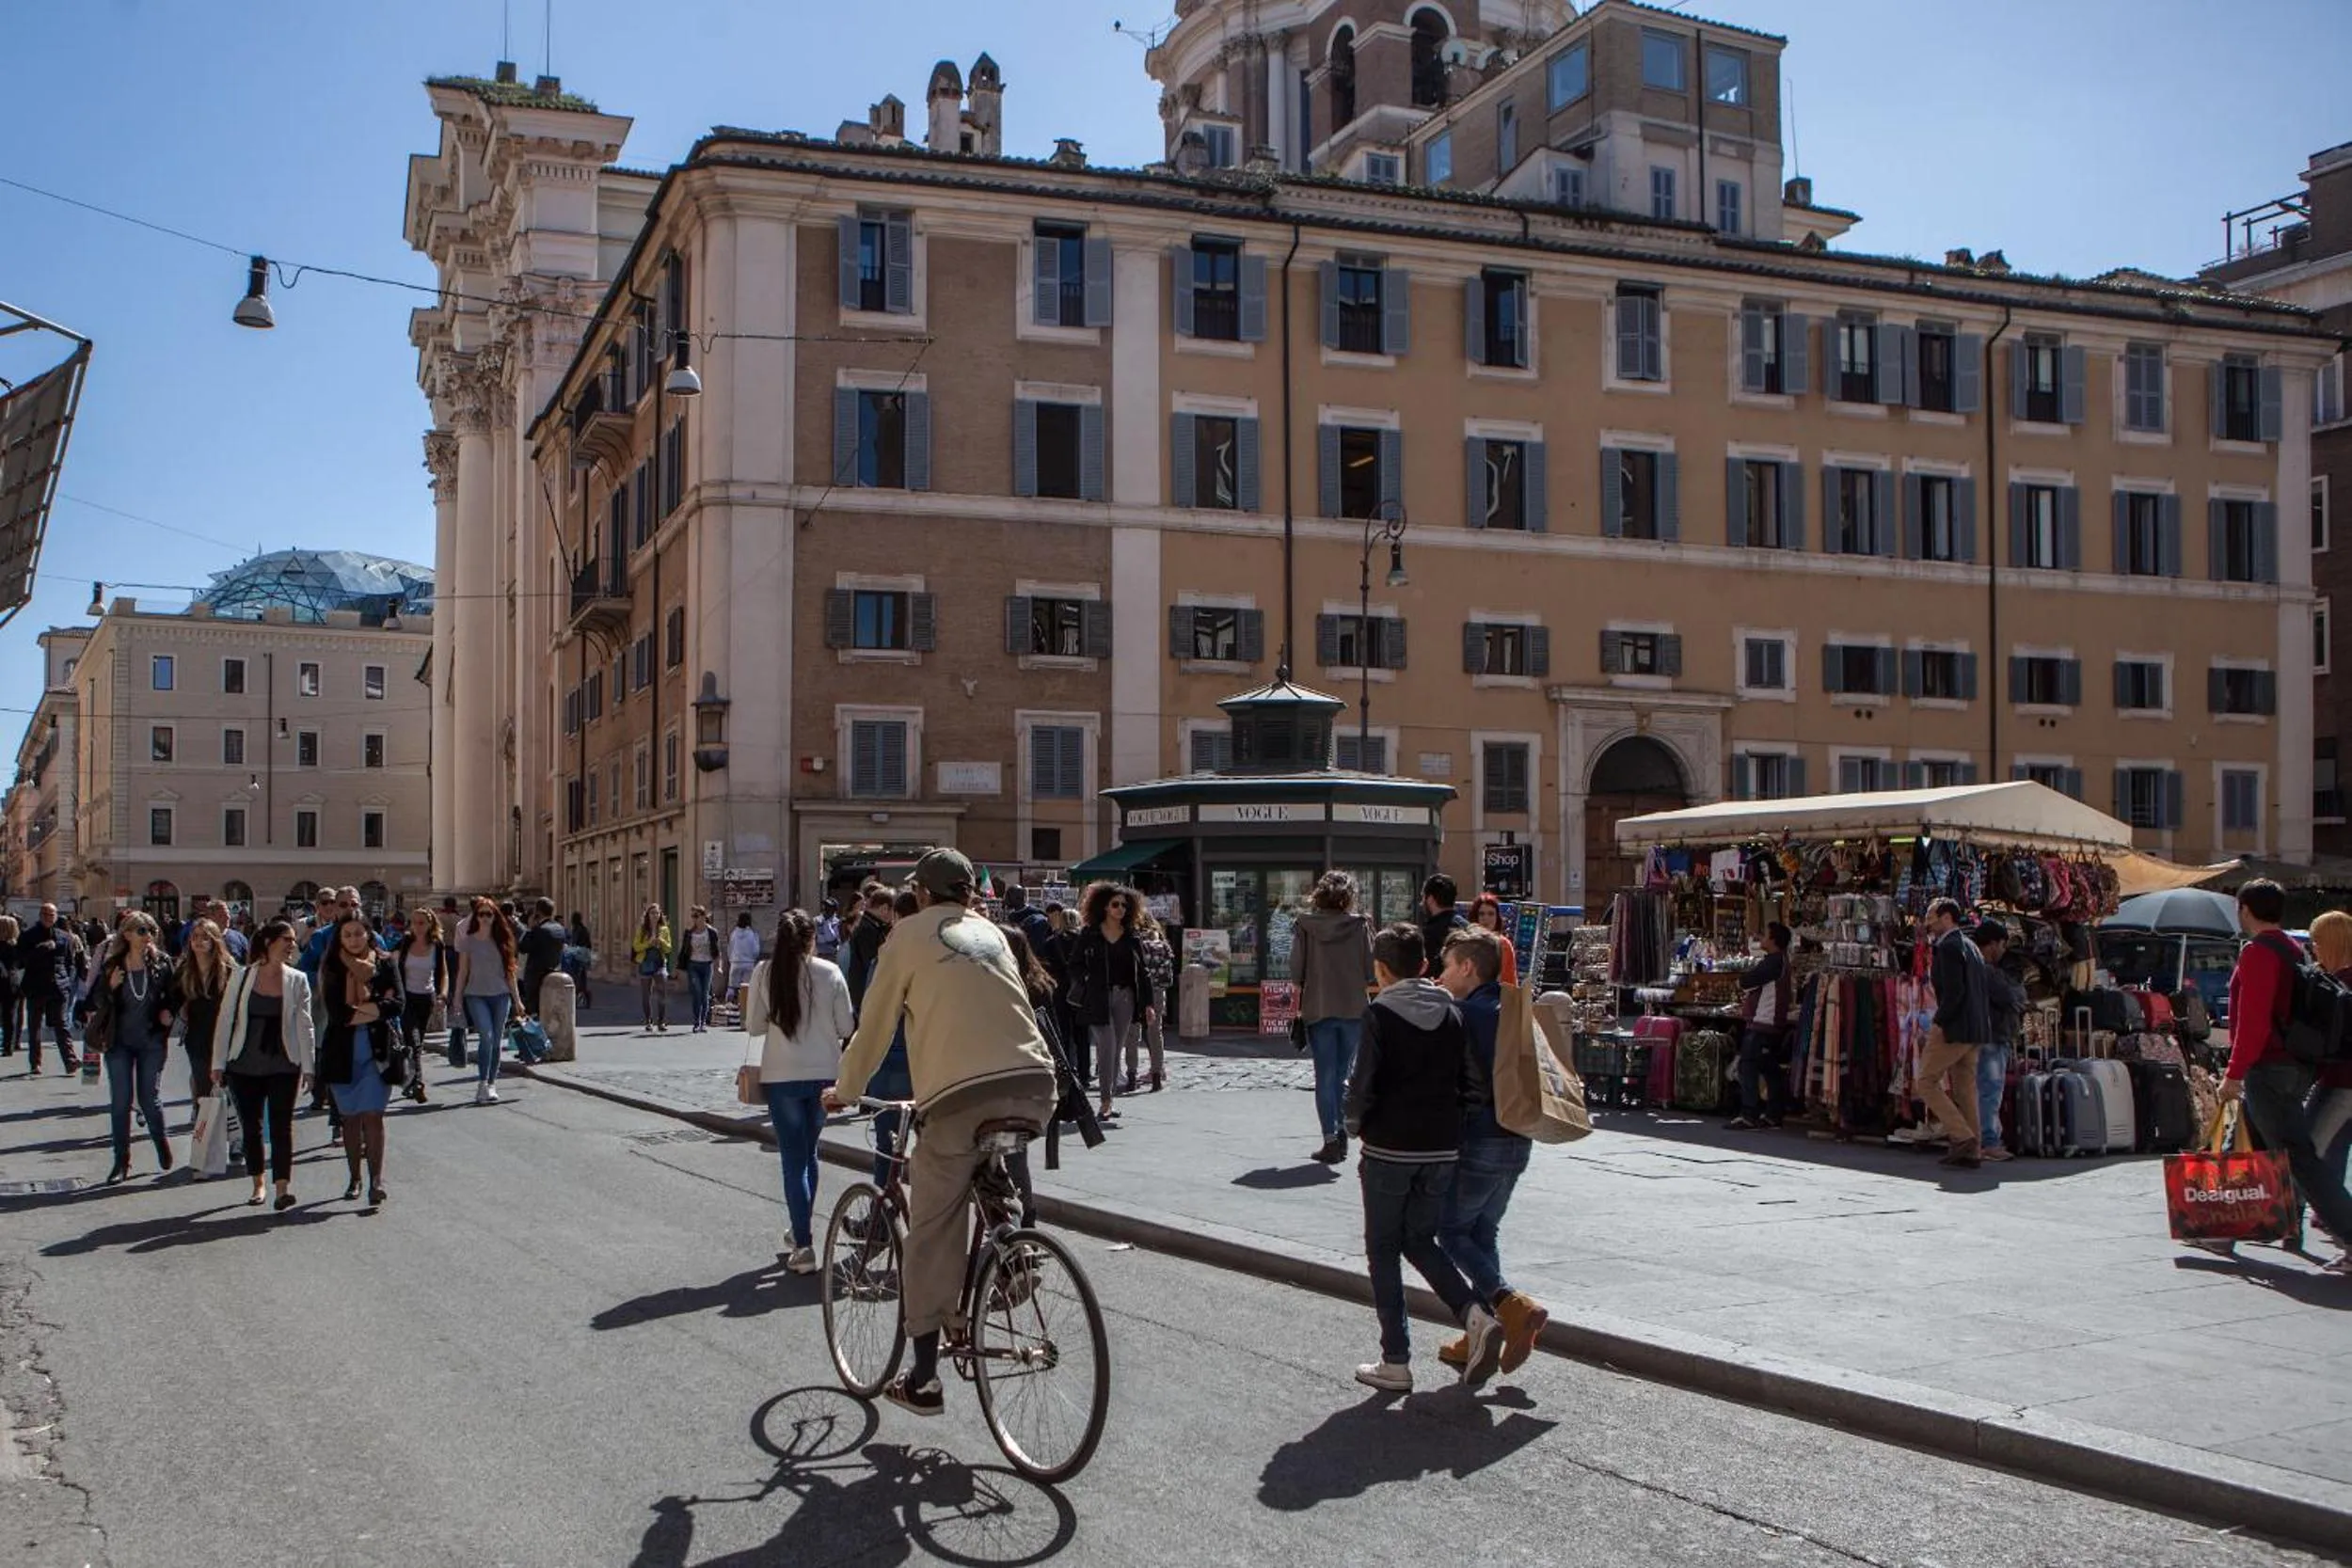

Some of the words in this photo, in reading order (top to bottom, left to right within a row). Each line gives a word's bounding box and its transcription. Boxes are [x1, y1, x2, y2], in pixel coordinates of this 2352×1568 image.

[1236, 805, 1289, 819] VOGUE
[1361, 806, 1403, 821] VOGUE
[1487, 852, 1519, 869] iShop
